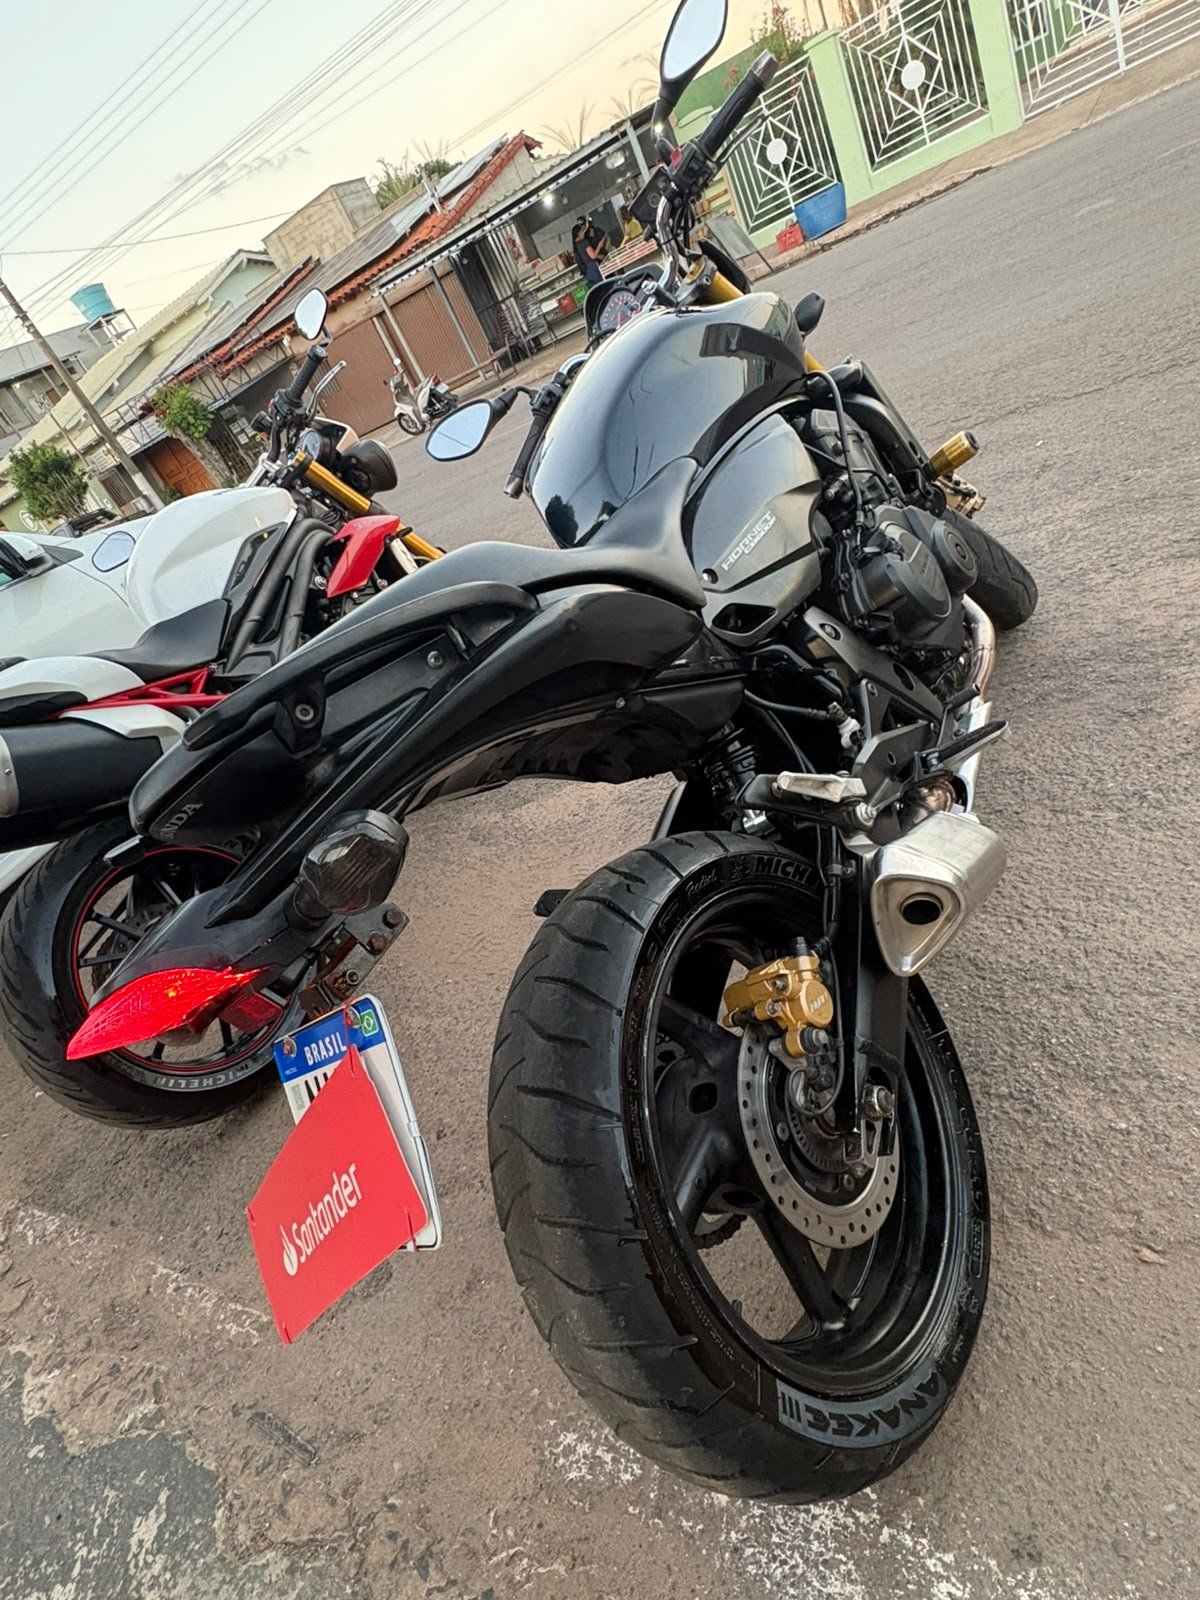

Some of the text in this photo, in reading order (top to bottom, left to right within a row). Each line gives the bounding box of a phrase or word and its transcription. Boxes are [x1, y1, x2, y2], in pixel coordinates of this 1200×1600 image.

[721, 510, 772, 571] HORNET
[303, 1031, 347, 1066] BRASIL
[292, 1161, 362, 1265] Santander
